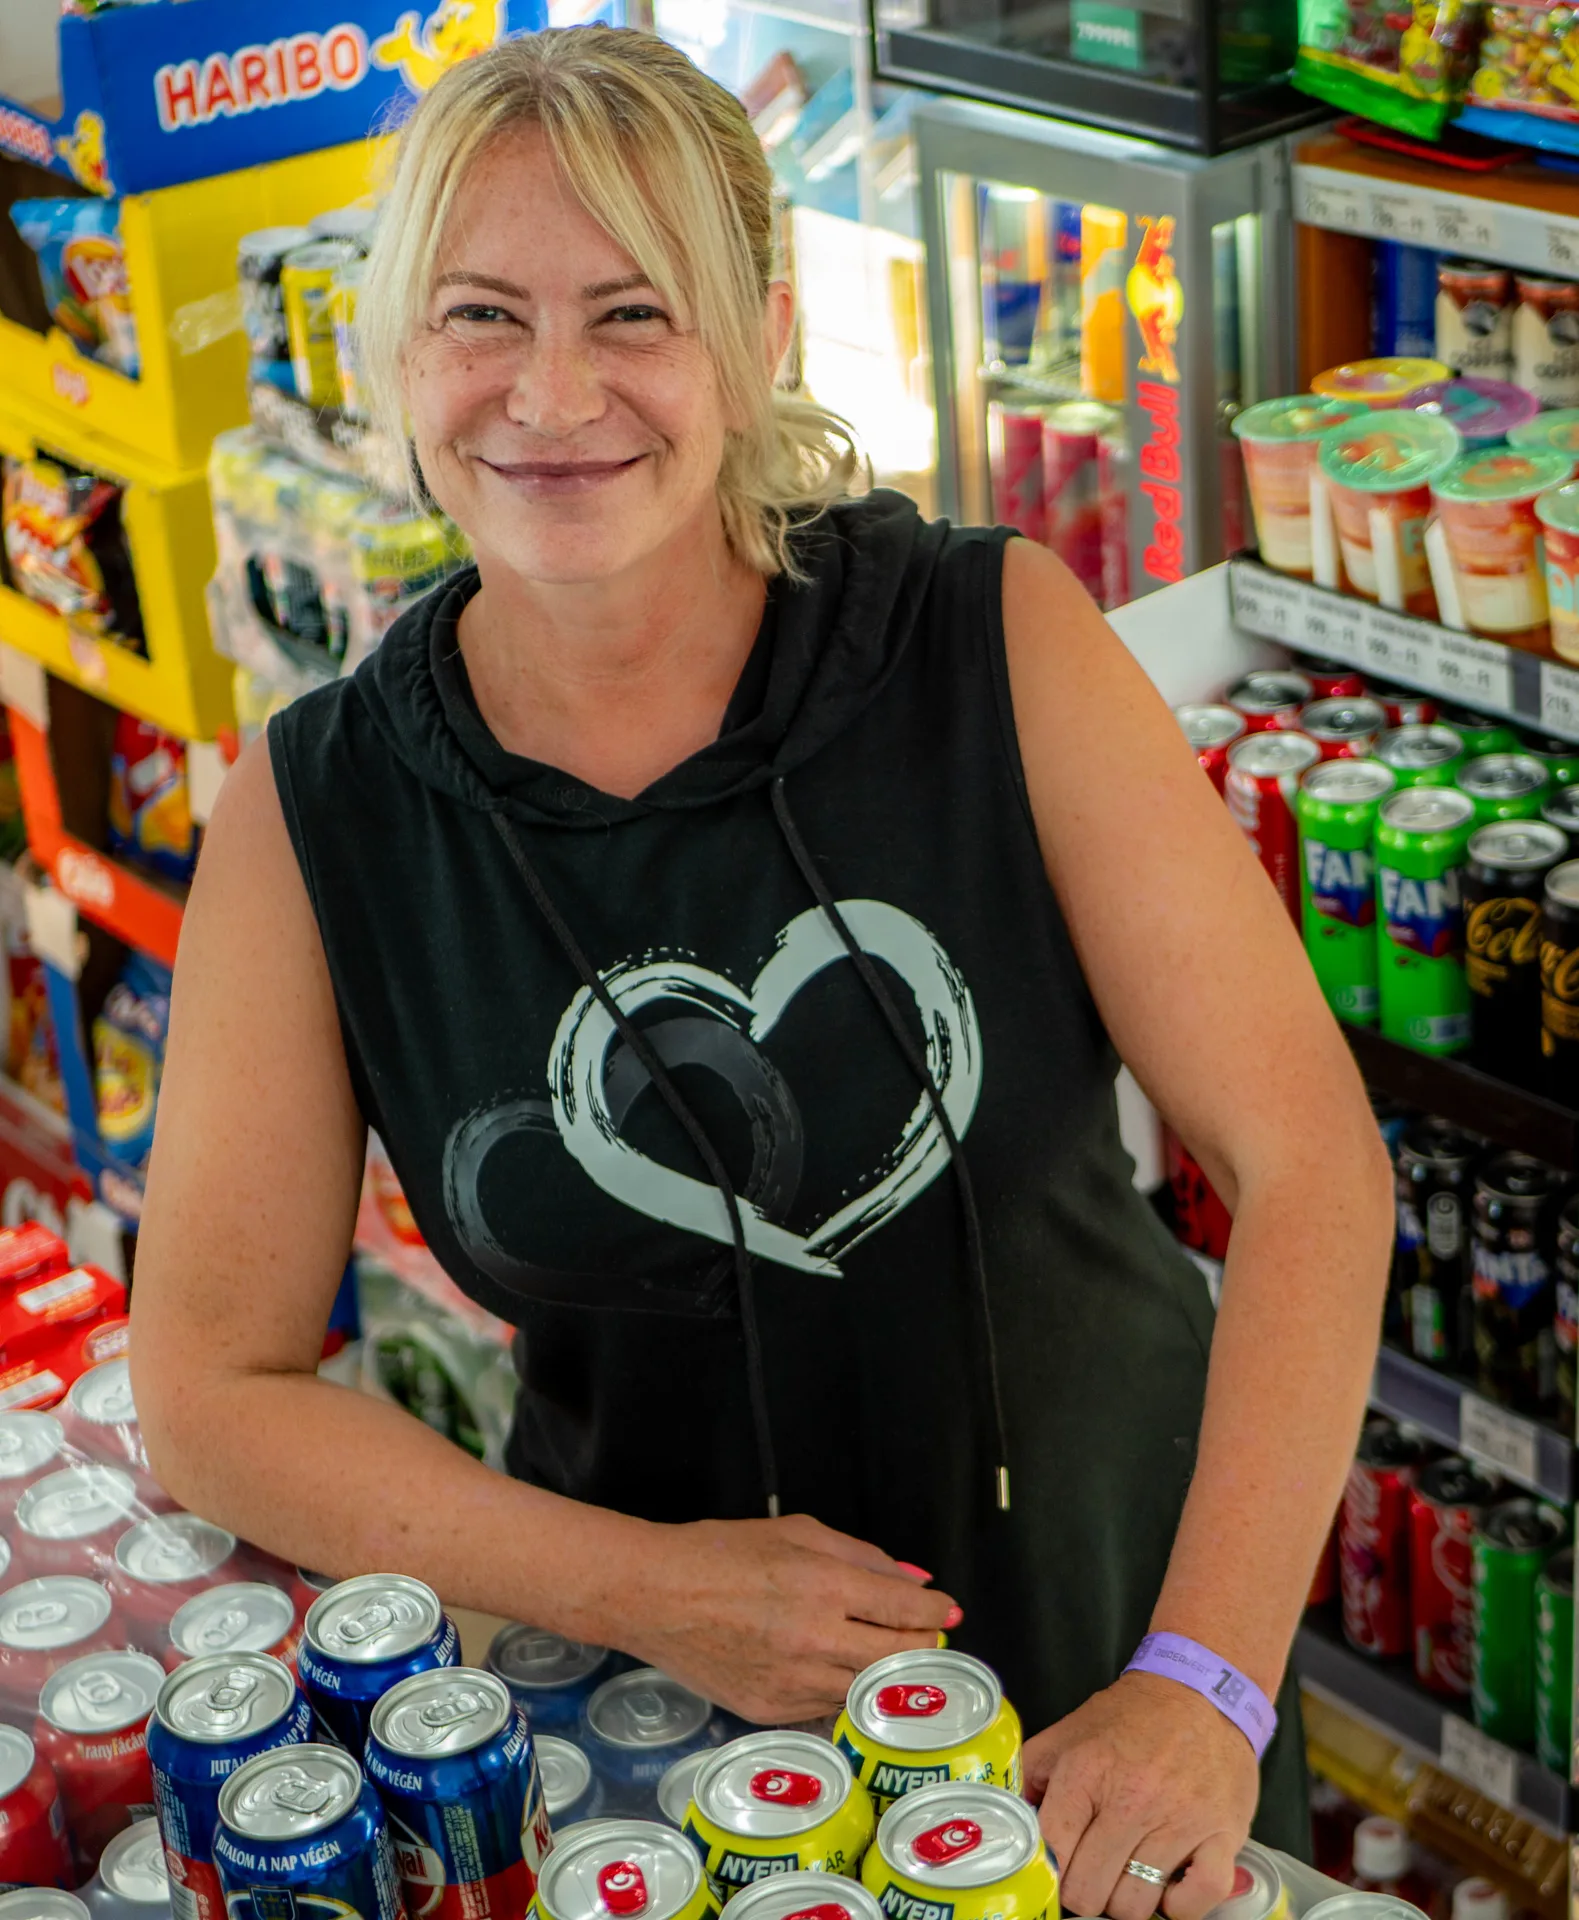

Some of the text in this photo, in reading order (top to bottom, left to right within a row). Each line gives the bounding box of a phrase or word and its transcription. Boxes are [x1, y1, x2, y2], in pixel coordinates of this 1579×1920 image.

[157, 26, 366, 130] HARIBO
[1136, 381, 1184, 583] Red Bull
[311, 1666, 341, 1691] VÉGÉN
[370, 1757, 388, 1780] NAP
[388, 1769, 422, 1791] VÉGÉN
[216, 1834, 341, 1872] JUTALOM A NAP VÉGÉN
